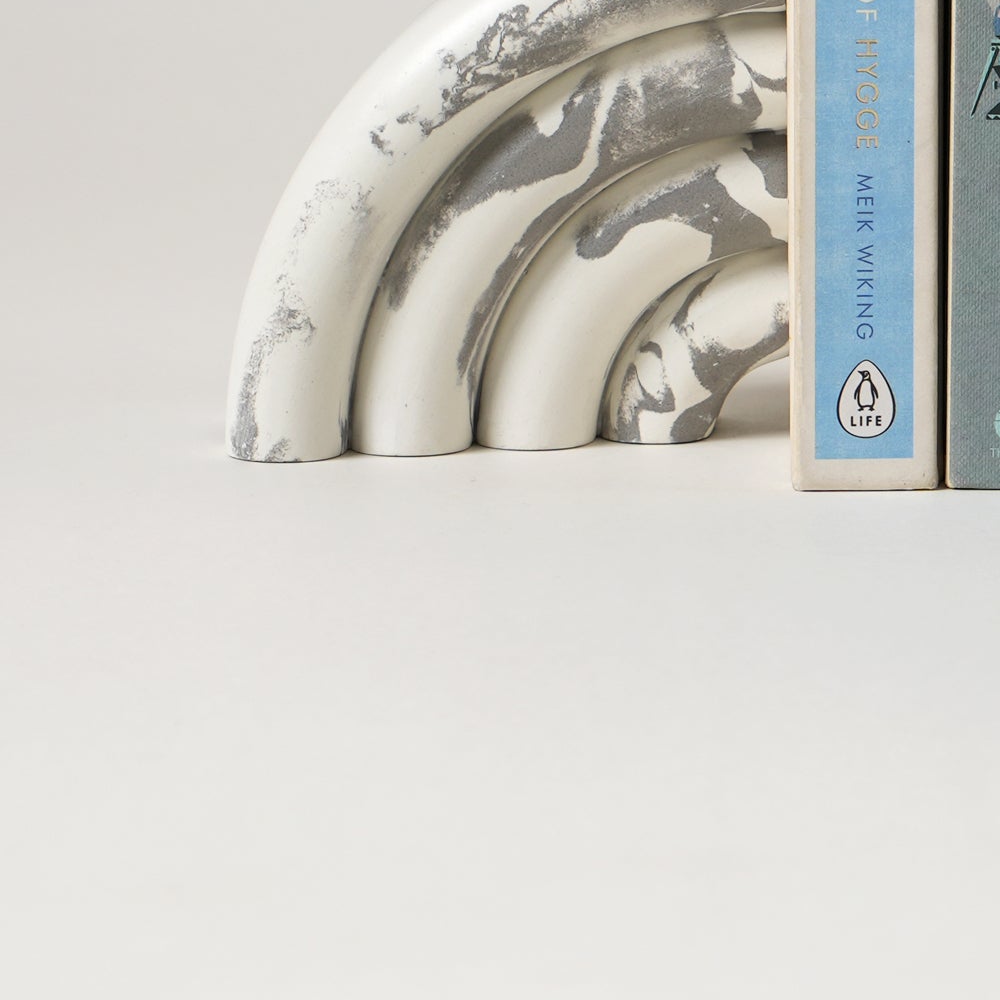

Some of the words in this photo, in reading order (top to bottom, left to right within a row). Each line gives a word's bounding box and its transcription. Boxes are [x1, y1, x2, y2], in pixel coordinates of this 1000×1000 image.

[855, 38, 880, 151] HYGGE
[855, 173, 875, 233] MEIK
[855, 244, 875, 341] WIKING
[849, 415, 883, 428] LIFE
